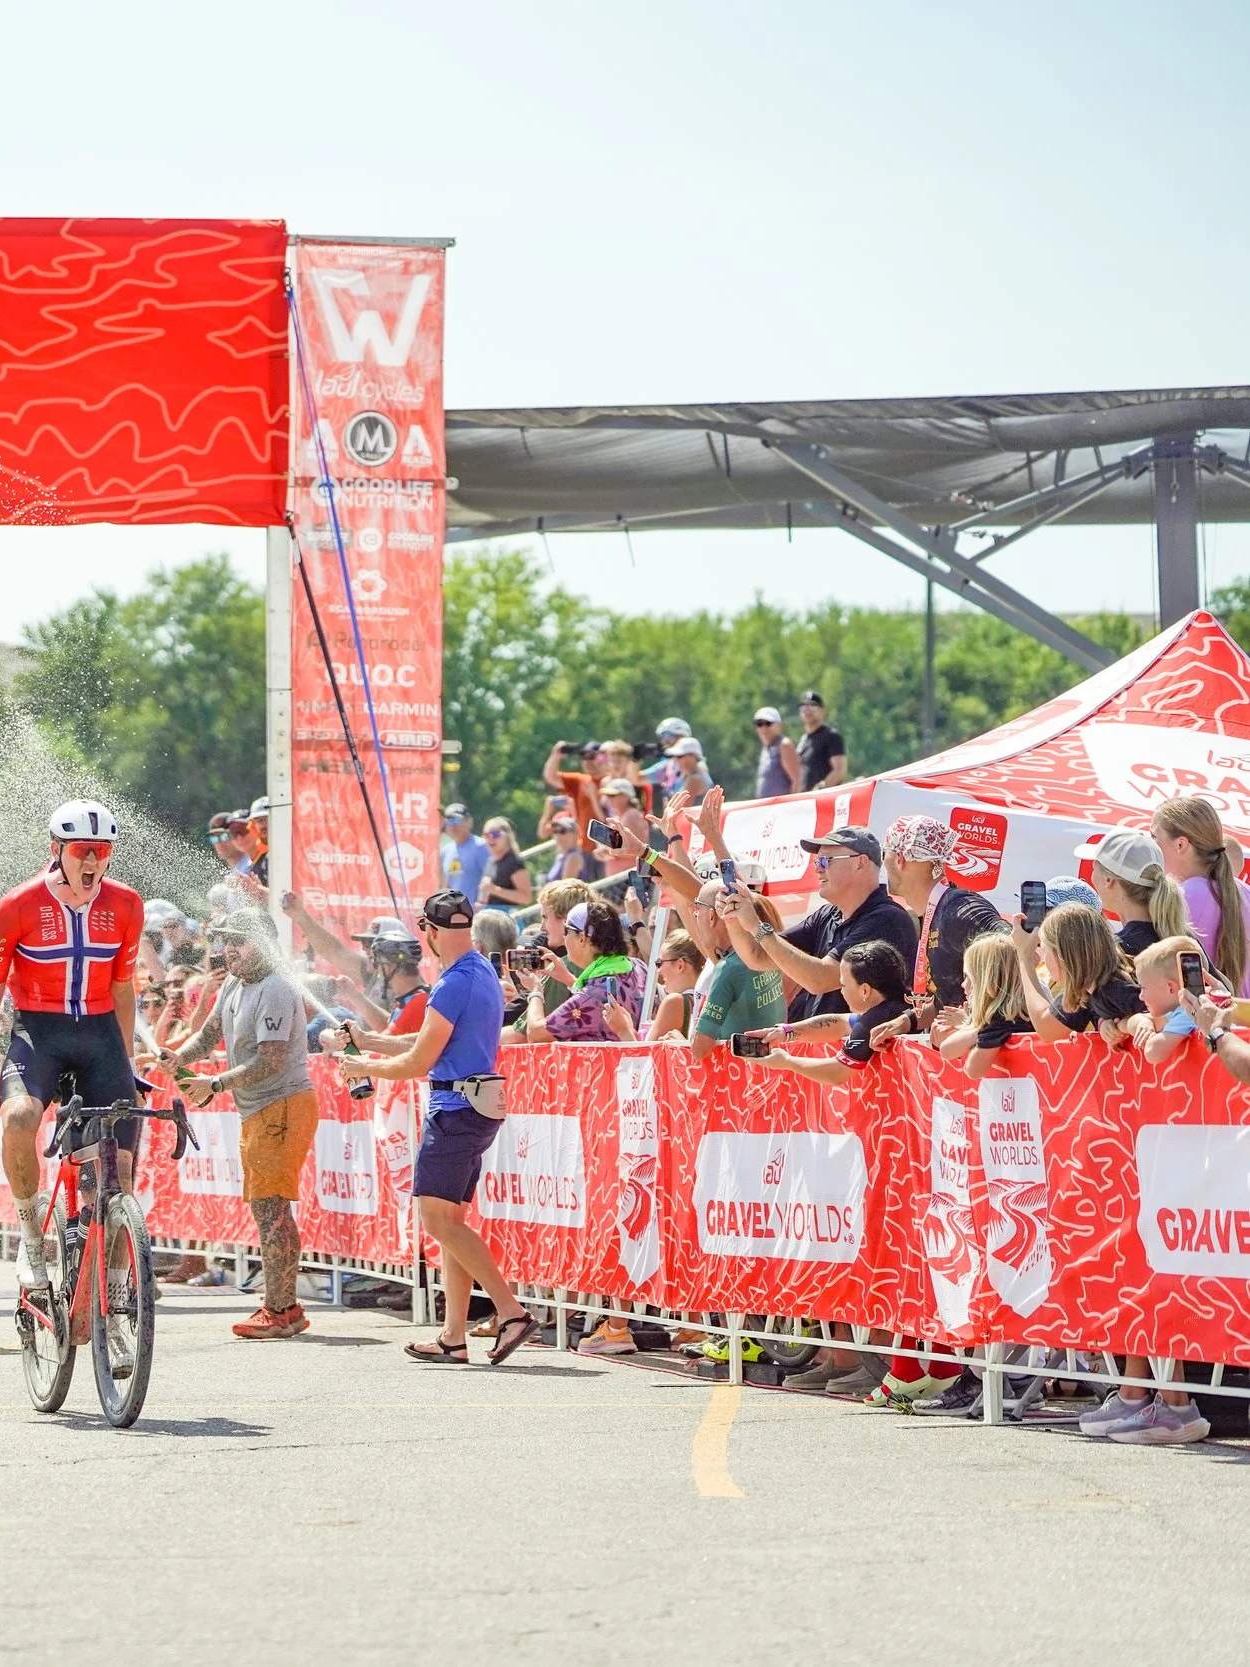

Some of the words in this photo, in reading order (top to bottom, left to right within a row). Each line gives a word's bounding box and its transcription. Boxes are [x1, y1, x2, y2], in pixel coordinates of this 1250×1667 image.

[341, 477, 434, 496] GOODLIFE
[341, 494, 435, 512] NUTRITION
[324, 661, 417, 688] QUOC
[362, 701, 438, 717] GARMIN
[384, 732, 434, 746] ABUS
[957, 822, 998, 837] GRAVEL
[989, 1122, 1035, 1142] GRAVEL
[706, 1199, 776, 1239] GRAVEL
